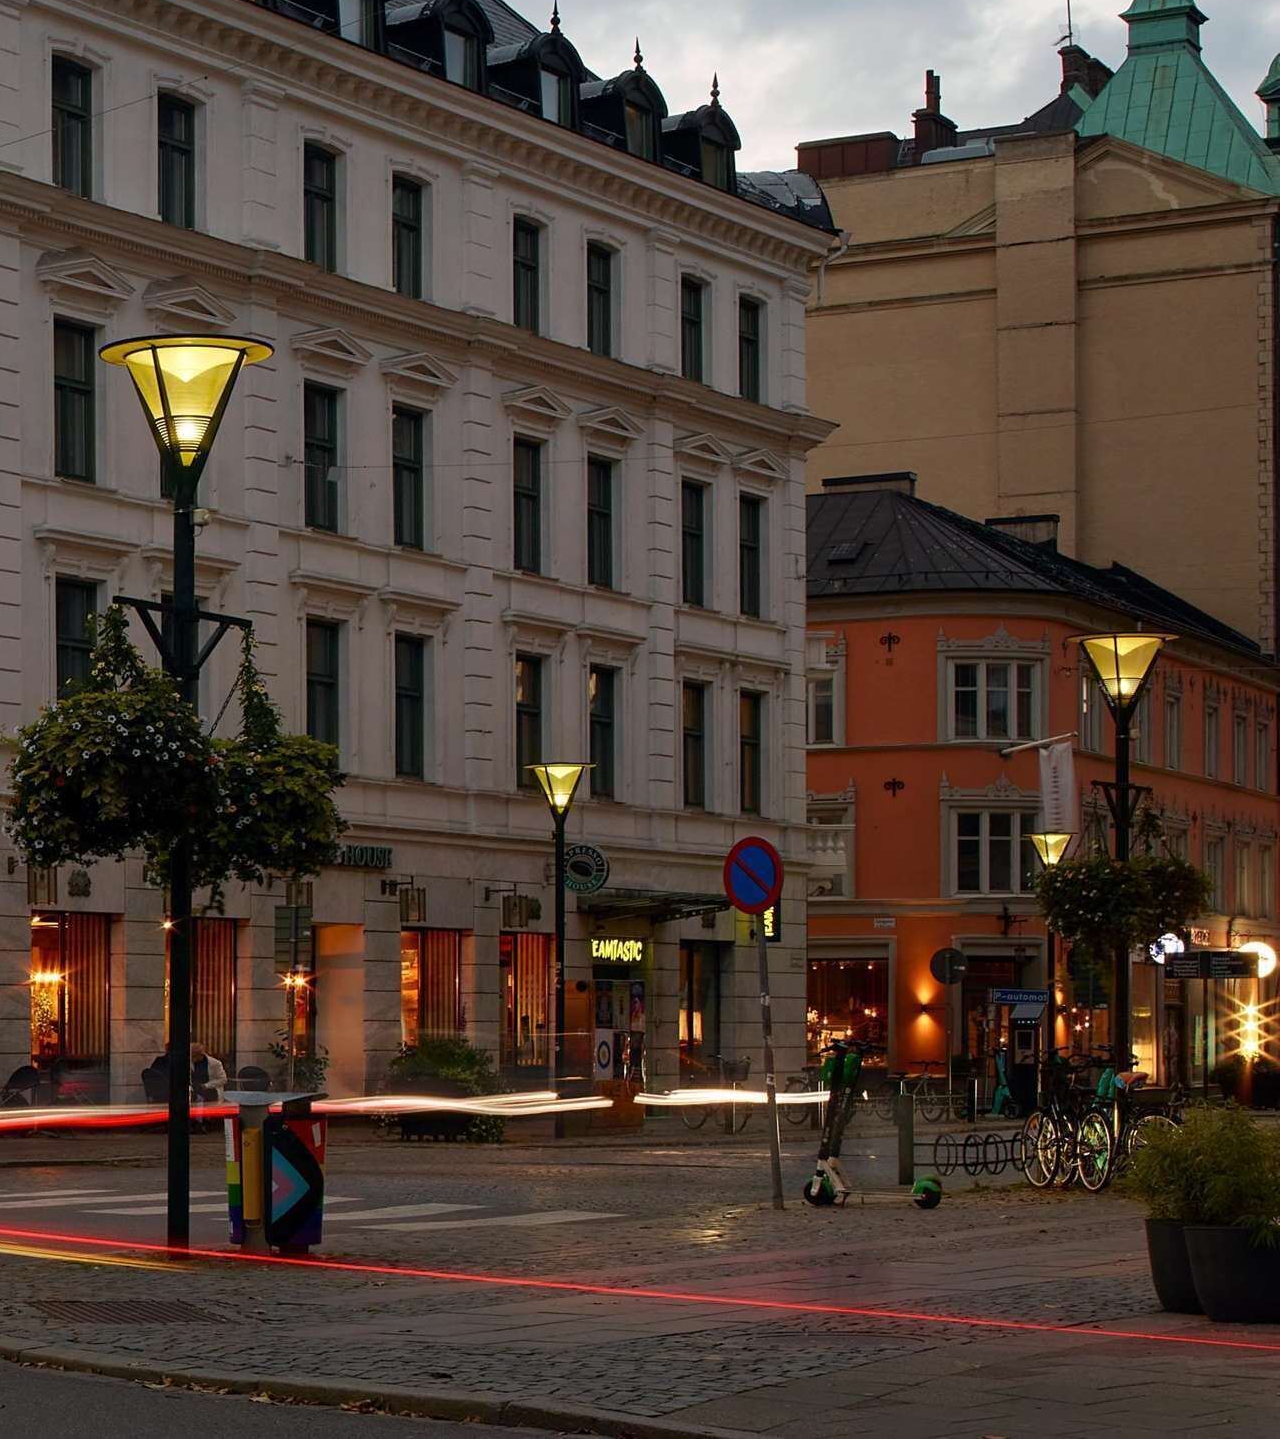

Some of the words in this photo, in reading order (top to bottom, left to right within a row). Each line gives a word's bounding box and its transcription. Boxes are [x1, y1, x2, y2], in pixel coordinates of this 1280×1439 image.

[344, 846, 393, 867] HOUSE
[565, 847, 603, 865] PRESSO
[591, 939, 643, 962] EAMTASTIC
[995, 992, 1048, 1001] P-automat
